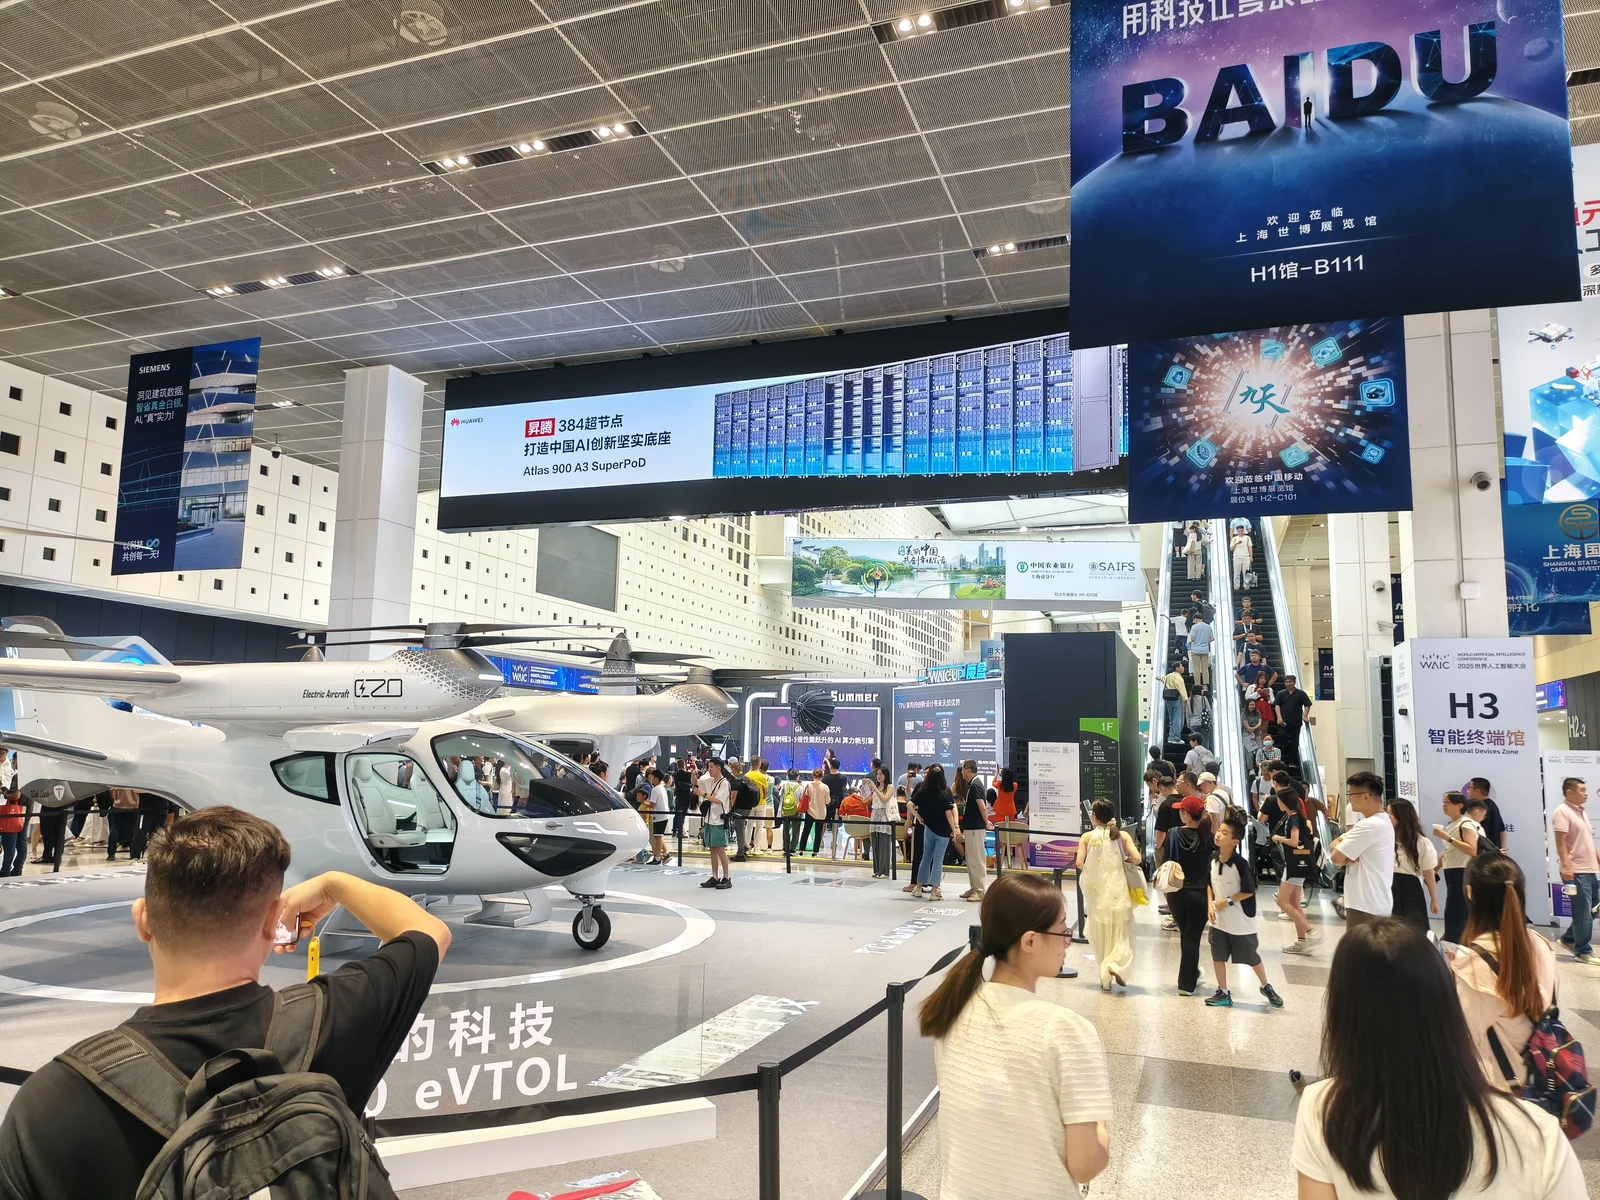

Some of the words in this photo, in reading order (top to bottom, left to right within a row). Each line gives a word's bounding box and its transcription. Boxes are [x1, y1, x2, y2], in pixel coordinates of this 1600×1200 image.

[1122, 20, 1498, 153] BAIDU
[1266, 206, 1344, 226] 欢迎莅临
[1235, 215, 1377, 243] 上海世博展览馆
[139, 363, 170, 374] SIEMENS
[1239, 383, 1290, 414] 九天
[527, 420, 553, 436] 昇腾
[558, 414, 624, 433] 384超节点
[524, 431, 671, 457] 打造中国AI创新坚实底座
[523, 466, 549, 477] Atlas
[552, 464, 572, 475] 900
[574, 462, 589, 473] A3
[591, 457, 647, 472] SuperPoD
[1224, 472, 1303, 485] 欢迎莅临中国移动
[1233, 484, 1294, 495] 上海世博展览馆
[1030, 561, 1074, 569] 中国农业银行
[1098, 561, 1136, 572] SAIFS
[1420, 661, 1450, 670] WAIC
[302, 689, 325, 698] Electric
[325, 689, 350, 698] Aircraft
[1449, 692, 1500, 720] H3
[1101, 722, 1114, 731] 1F
[1428, 728, 1526, 747] 智能终端馆
[415, 1054, 578, 1110] eVTOL
